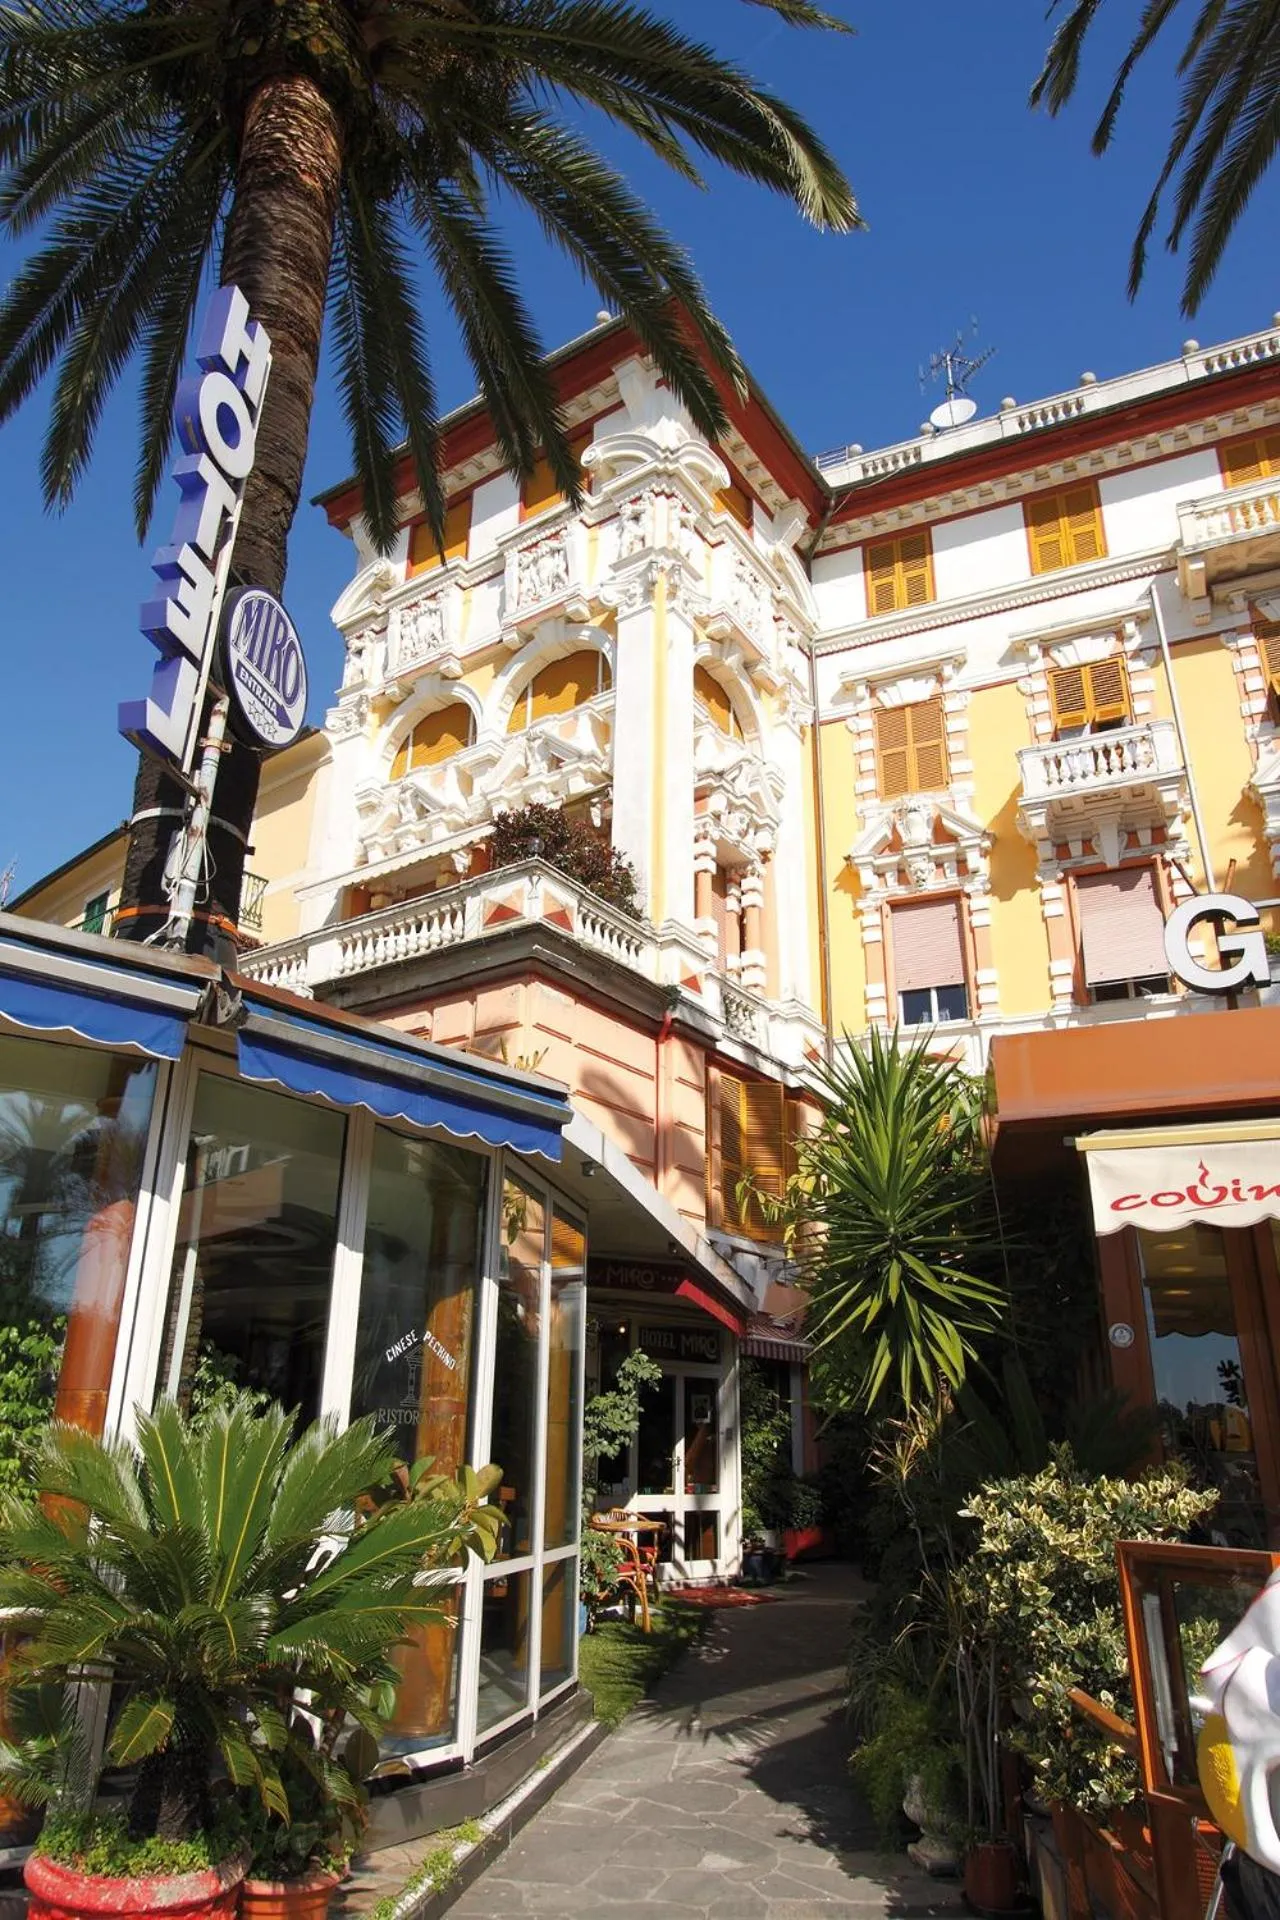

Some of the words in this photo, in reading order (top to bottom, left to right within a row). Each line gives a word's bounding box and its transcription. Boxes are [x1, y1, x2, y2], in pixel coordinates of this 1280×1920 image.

[119, 285, 271, 766] HOTEL
[239, 667, 279, 717] ENTRATA
[1165, 893, 1272, 996] G
[385, 1329, 419, 1363] CINESE
[423, 1330, 457, 1371] PECHINO
